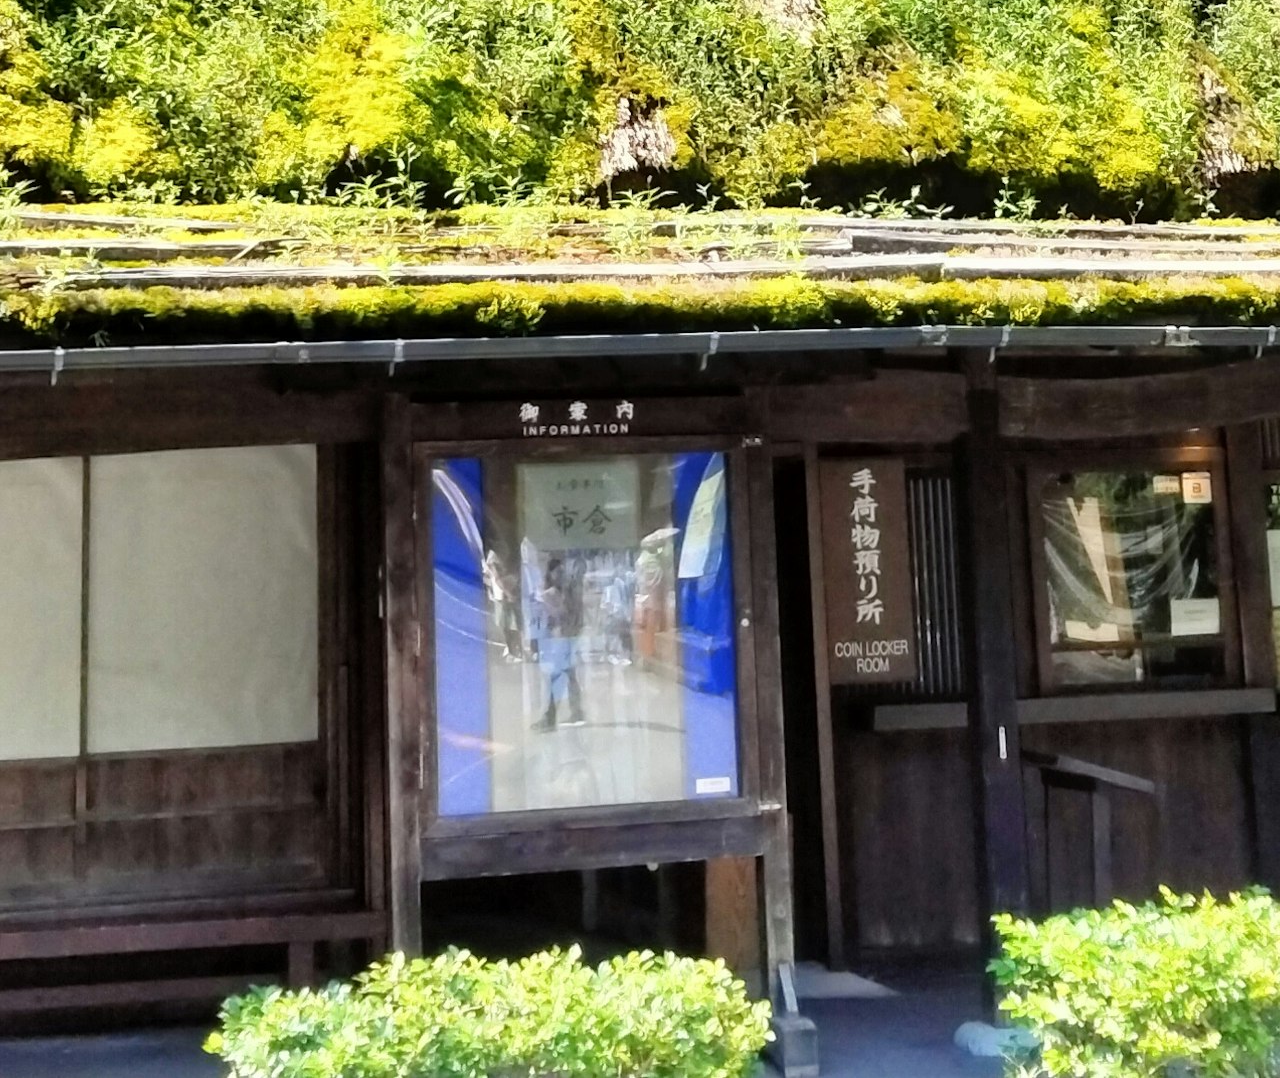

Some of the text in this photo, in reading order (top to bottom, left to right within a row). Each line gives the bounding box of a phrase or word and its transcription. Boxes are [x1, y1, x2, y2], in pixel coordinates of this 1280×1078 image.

[518, 399, 635, 423] 御案内
[522, 423, 629, 436] INFORMATION
[551, 504, 612, 537] 市倉
[849, 468, 884, 625] 手荷物預り所
[835, 639, 909, 657] COIN LOCKER
[856, 657, 890, 673] ROOM
